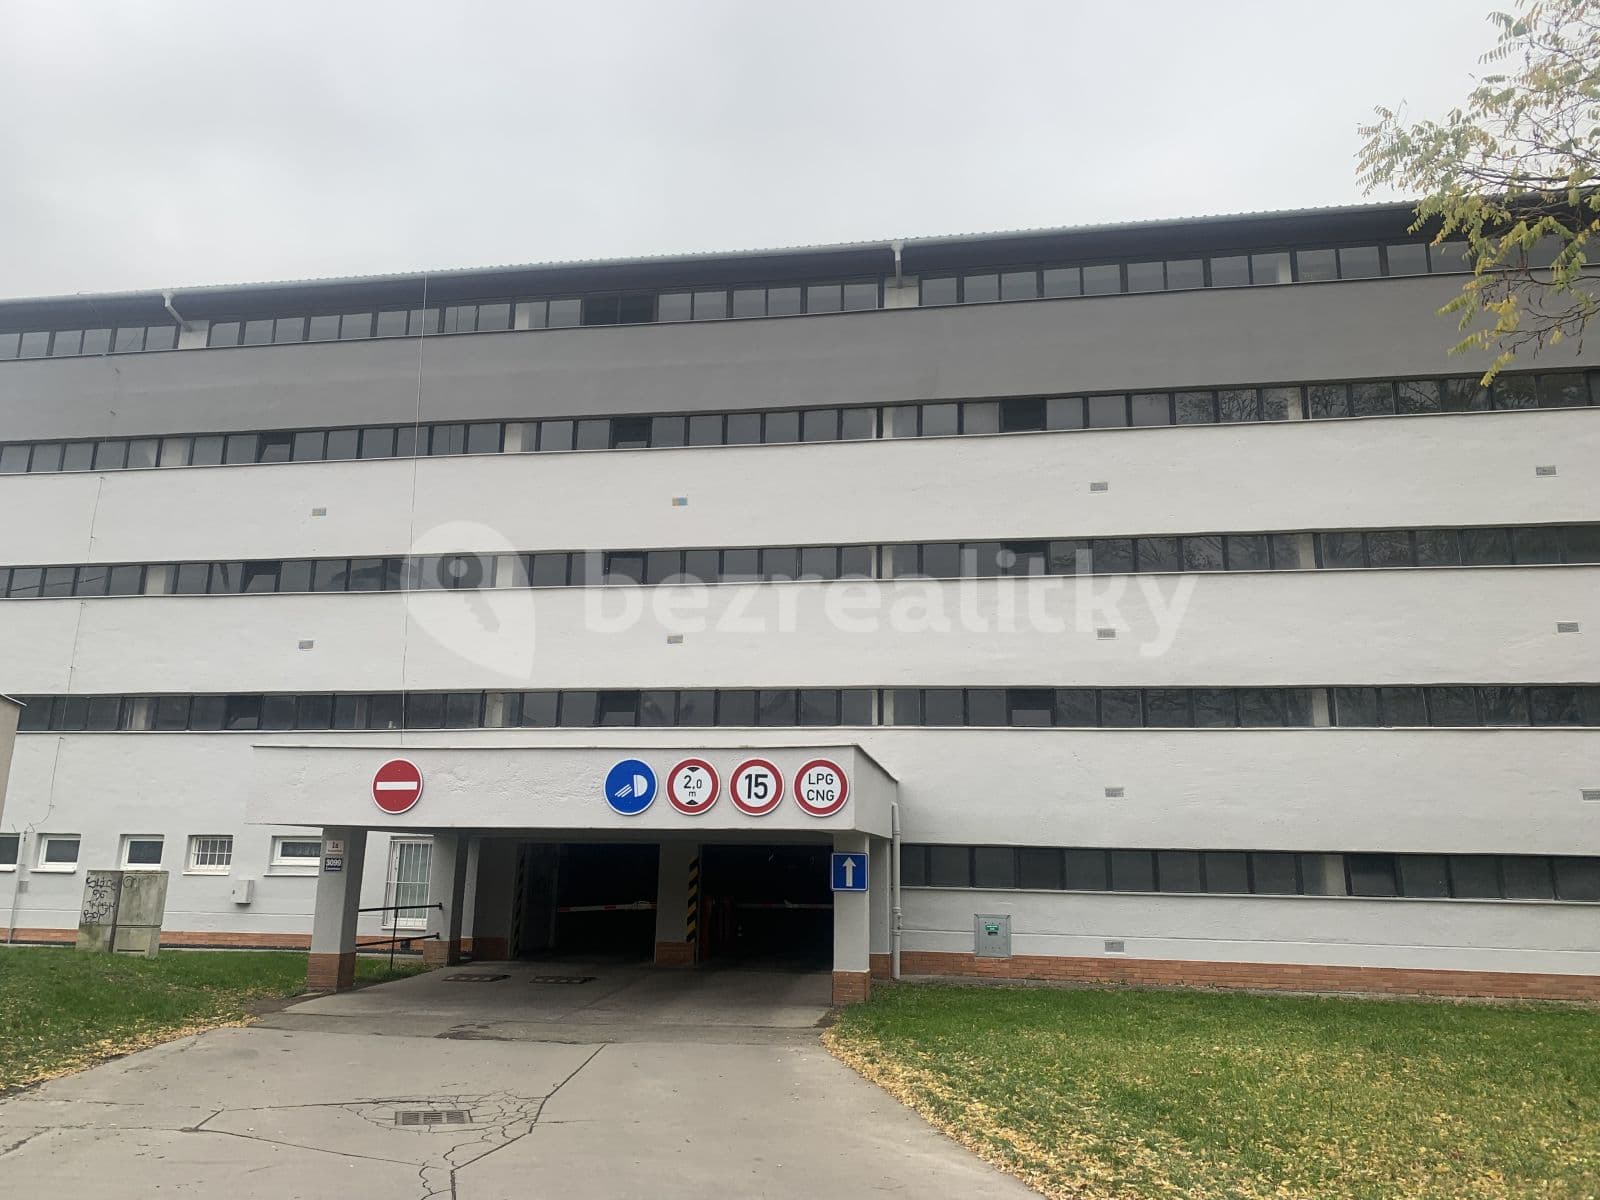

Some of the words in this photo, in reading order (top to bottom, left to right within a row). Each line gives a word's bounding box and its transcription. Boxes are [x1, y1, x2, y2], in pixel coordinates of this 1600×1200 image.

[684, 775, 702, 789] 2,0
[808, 773, 834, 785] LPG
[745, 774, 768, 799] 15
[806, 789, 835, 801] CNG
